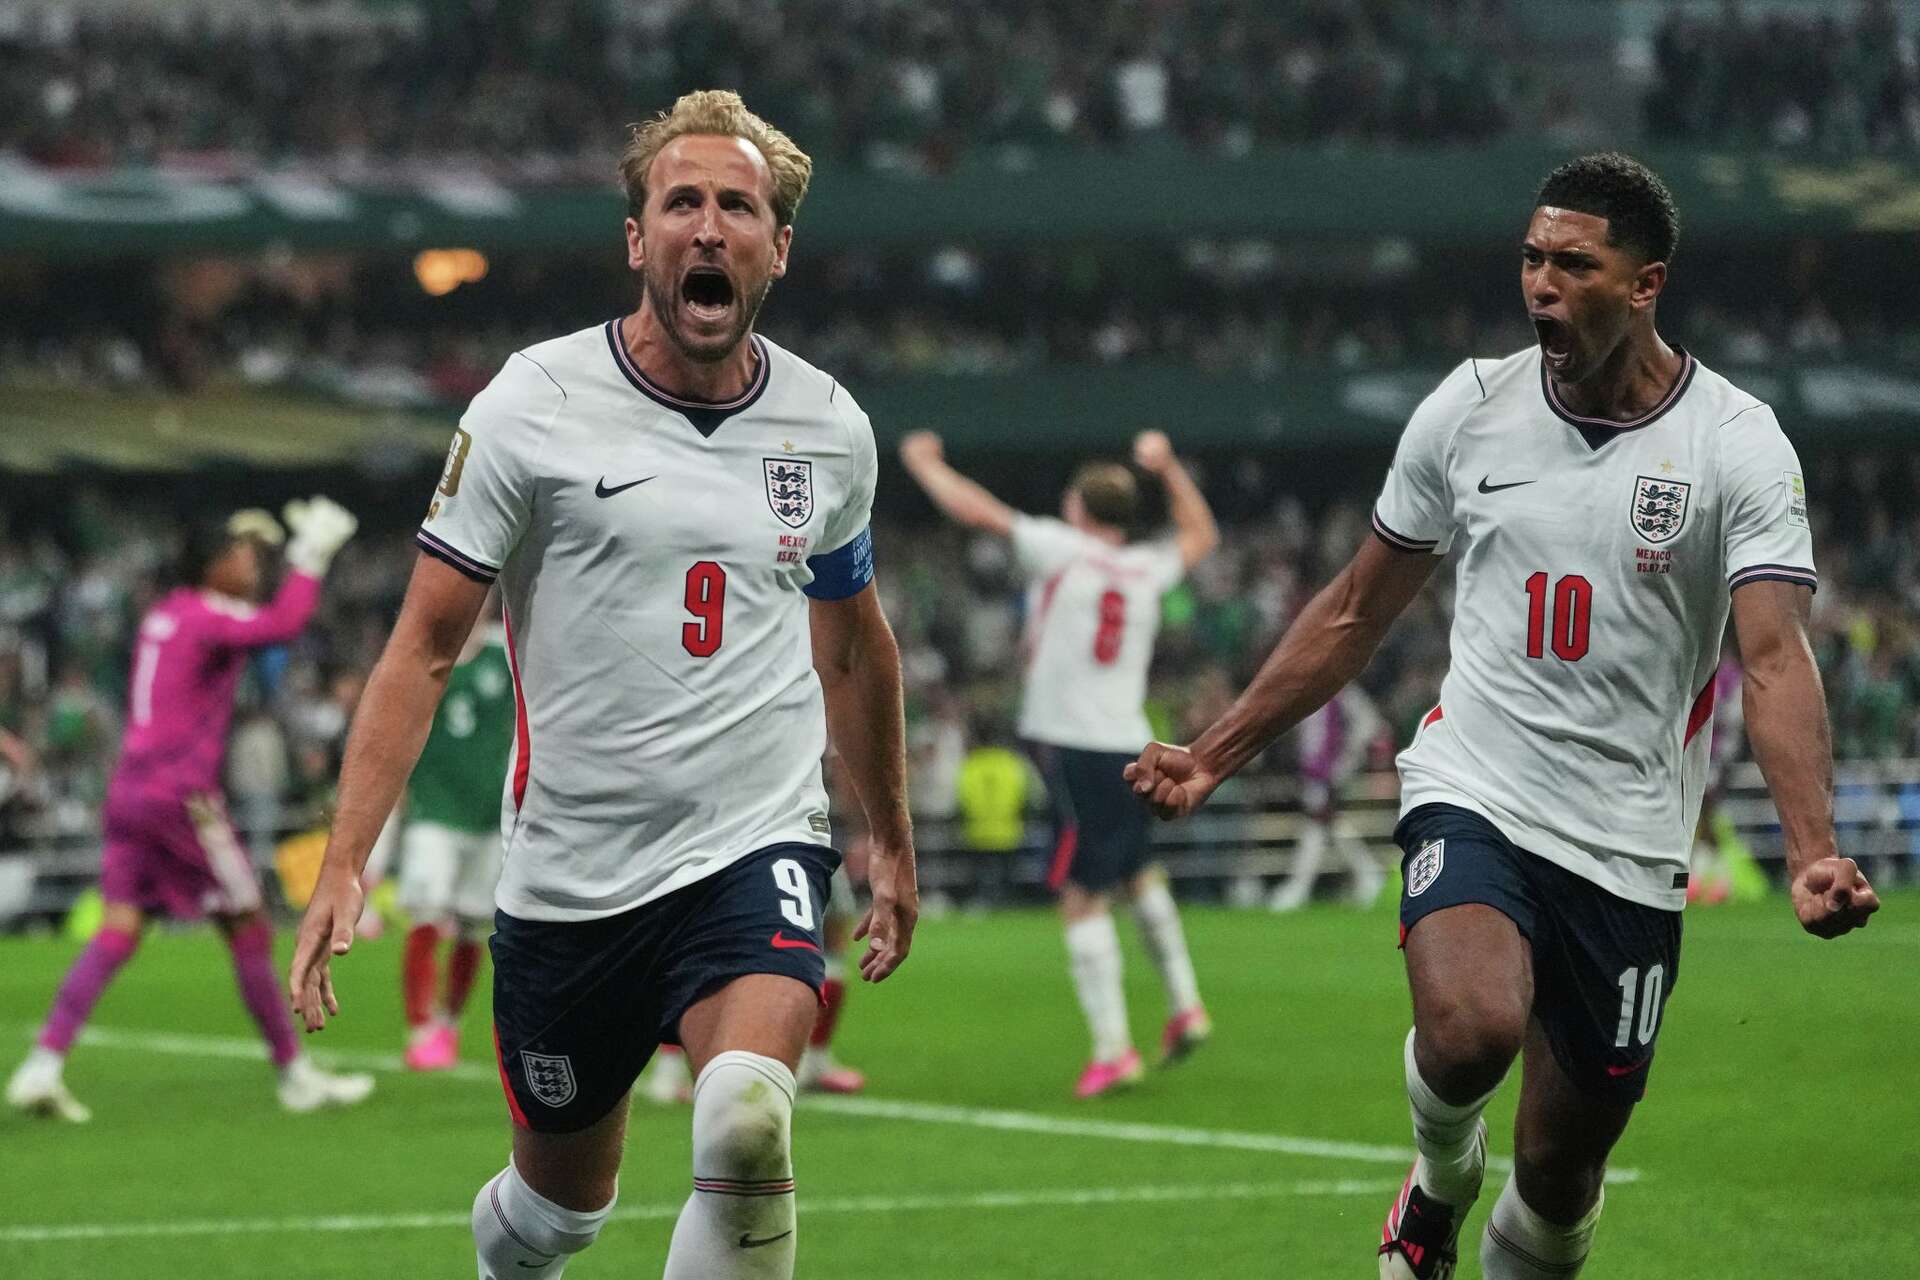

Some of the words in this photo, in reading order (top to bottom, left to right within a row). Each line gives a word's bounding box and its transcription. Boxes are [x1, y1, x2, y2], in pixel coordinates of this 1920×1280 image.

[1636, 548, 1671, 560] MEXICO
[682, 561, 726, 657] 9
[1525, 572, 1593, 662] 10
[772, 859, 815, 931] 9
[1615, 964, 1664, 1047] 10
